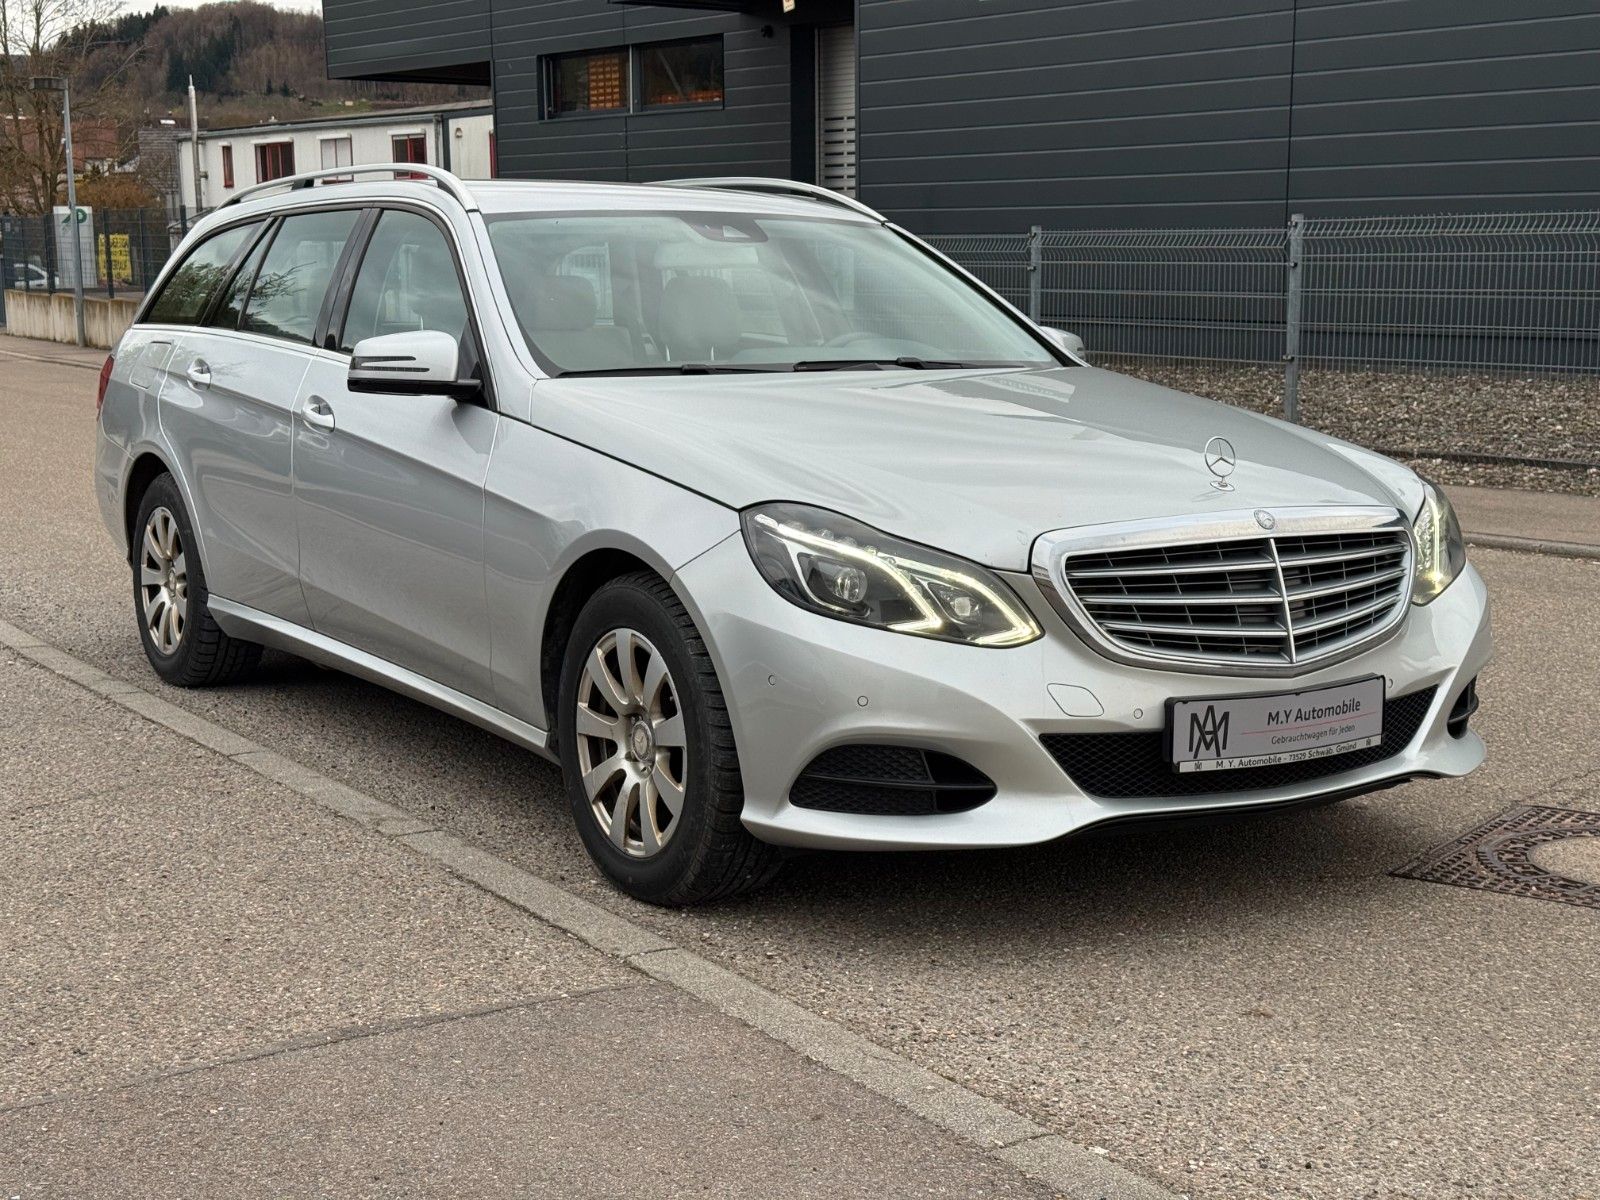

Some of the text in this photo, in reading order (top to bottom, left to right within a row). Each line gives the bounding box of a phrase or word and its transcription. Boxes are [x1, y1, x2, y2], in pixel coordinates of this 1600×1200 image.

[1267, 698, 1361, 725] M.Y Automobile
[1271, 730, 1328, 745] Gebrauchtwagen
[1329, 726, 1338, 736] für
[1238, 755, 1282, 766] Automobile
[1289, 751, 1307, 761] 73529
